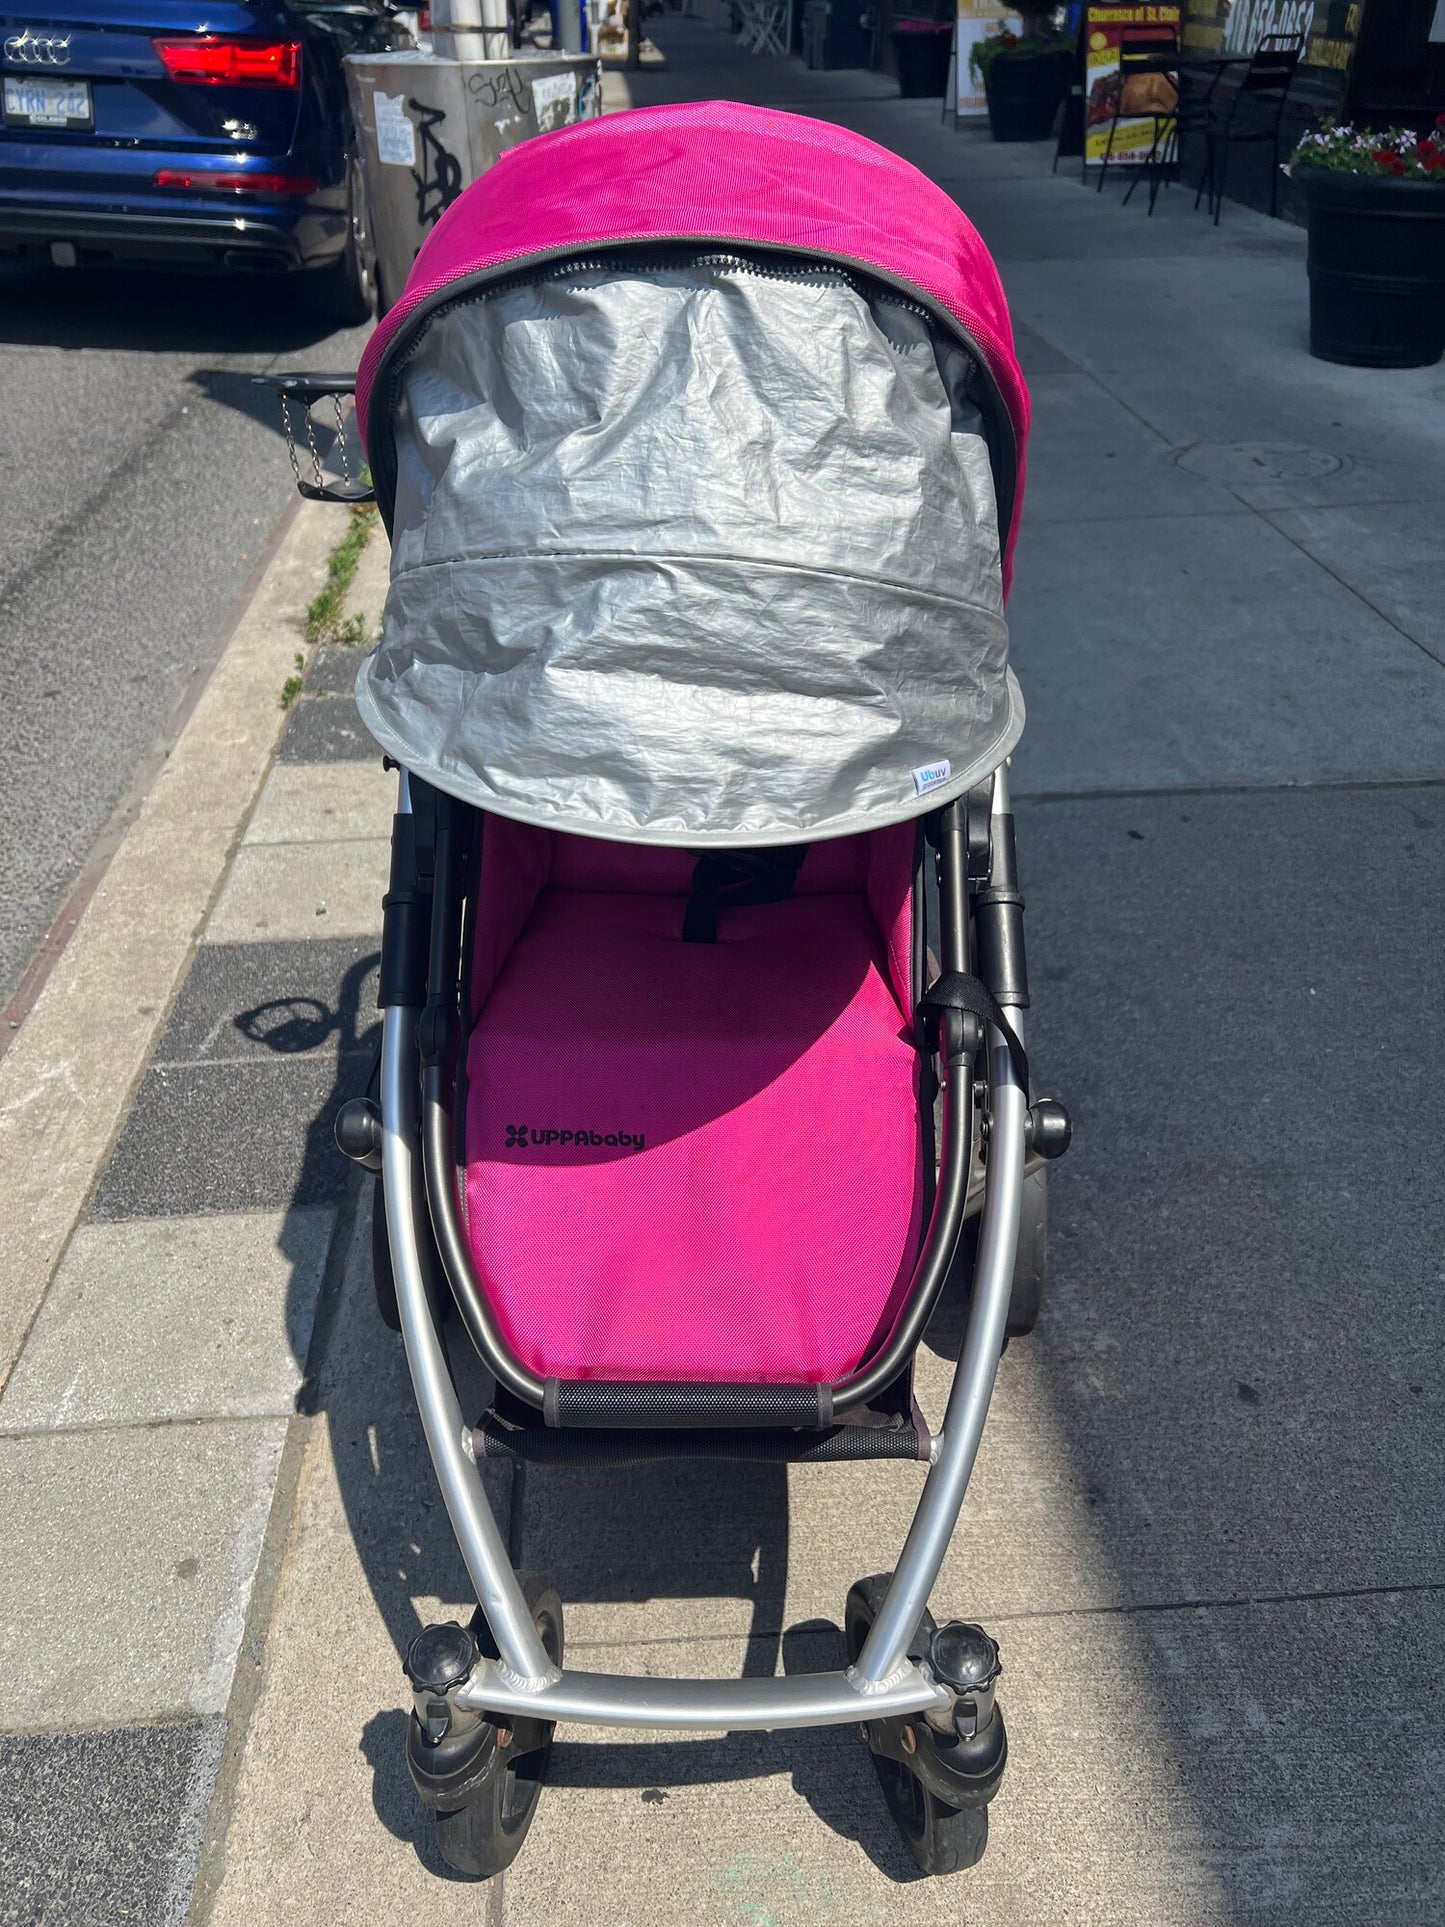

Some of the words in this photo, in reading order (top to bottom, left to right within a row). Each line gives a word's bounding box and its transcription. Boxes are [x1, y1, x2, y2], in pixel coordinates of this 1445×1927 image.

[6, 89, 46, 112] CYRN
[56, 91, 86, 116] 242
[531, 1129, 645, 1151] UPPAbaby
